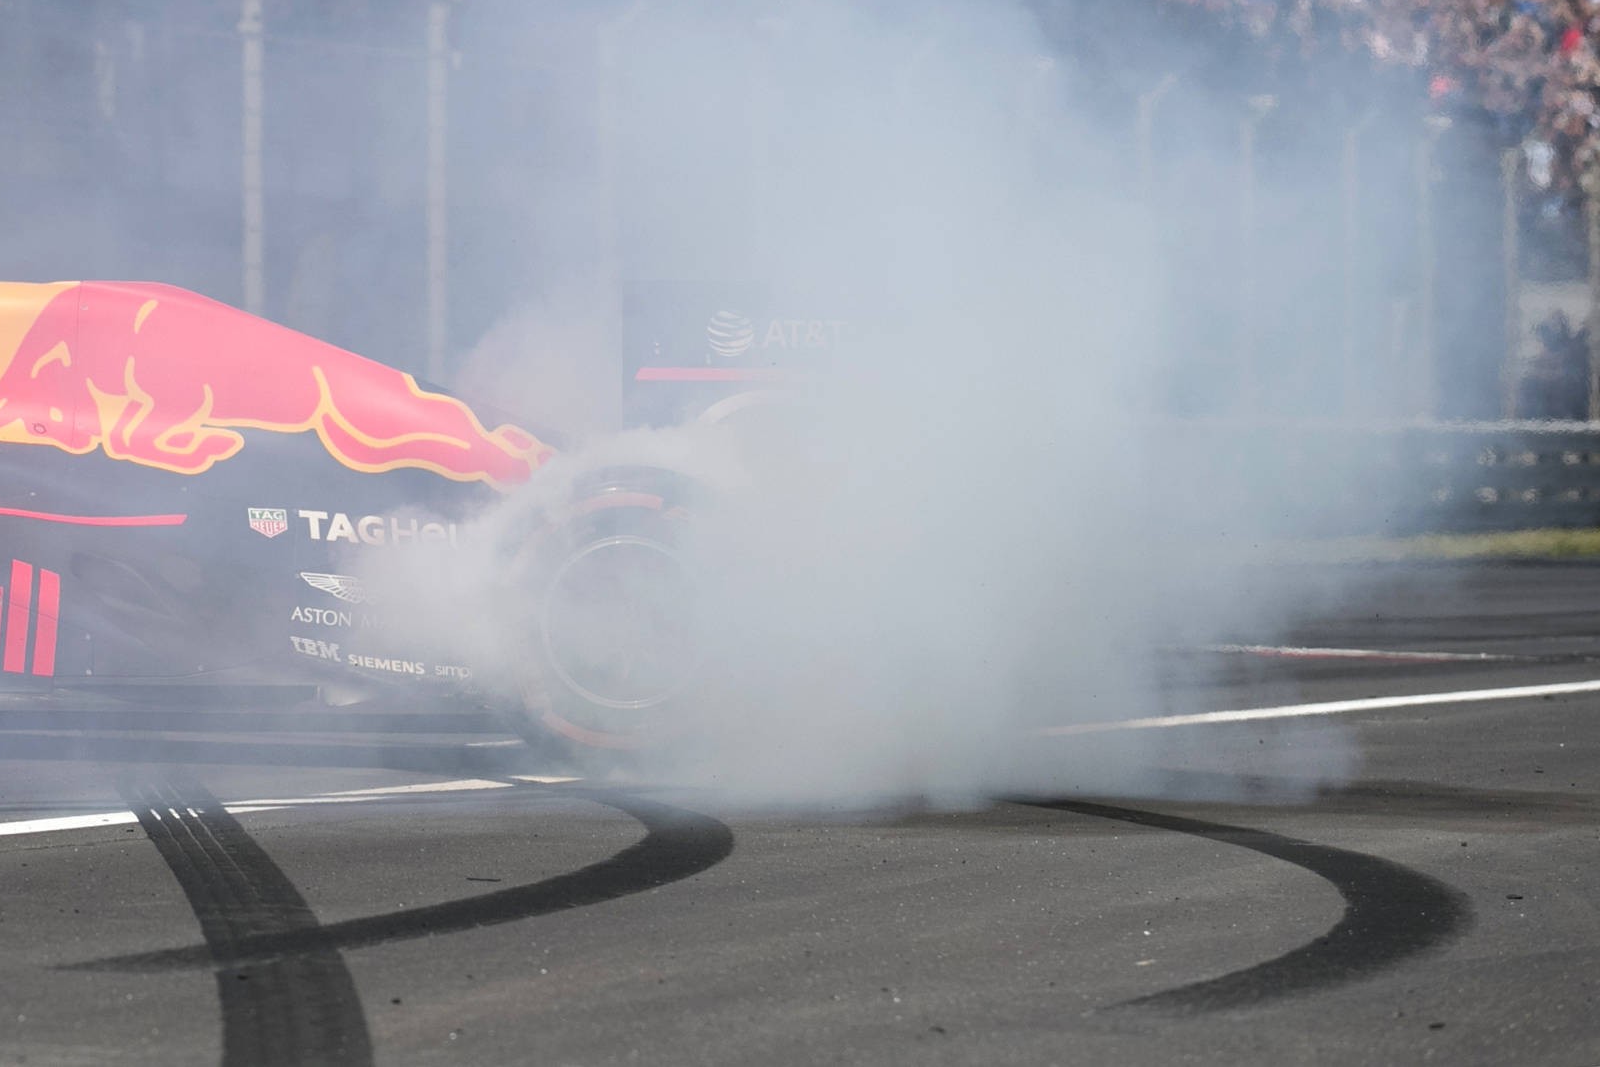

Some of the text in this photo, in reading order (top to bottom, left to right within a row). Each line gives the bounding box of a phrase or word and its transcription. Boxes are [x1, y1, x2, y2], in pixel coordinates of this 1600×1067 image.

[762, 318, 849, 350] AT&T
[251, 510, 284, 520] TAG
[291, 606, 352, 627] ASTON
[290, 636, 341, 662] IBM
[348, 653, 425, 675] SIEMENS
